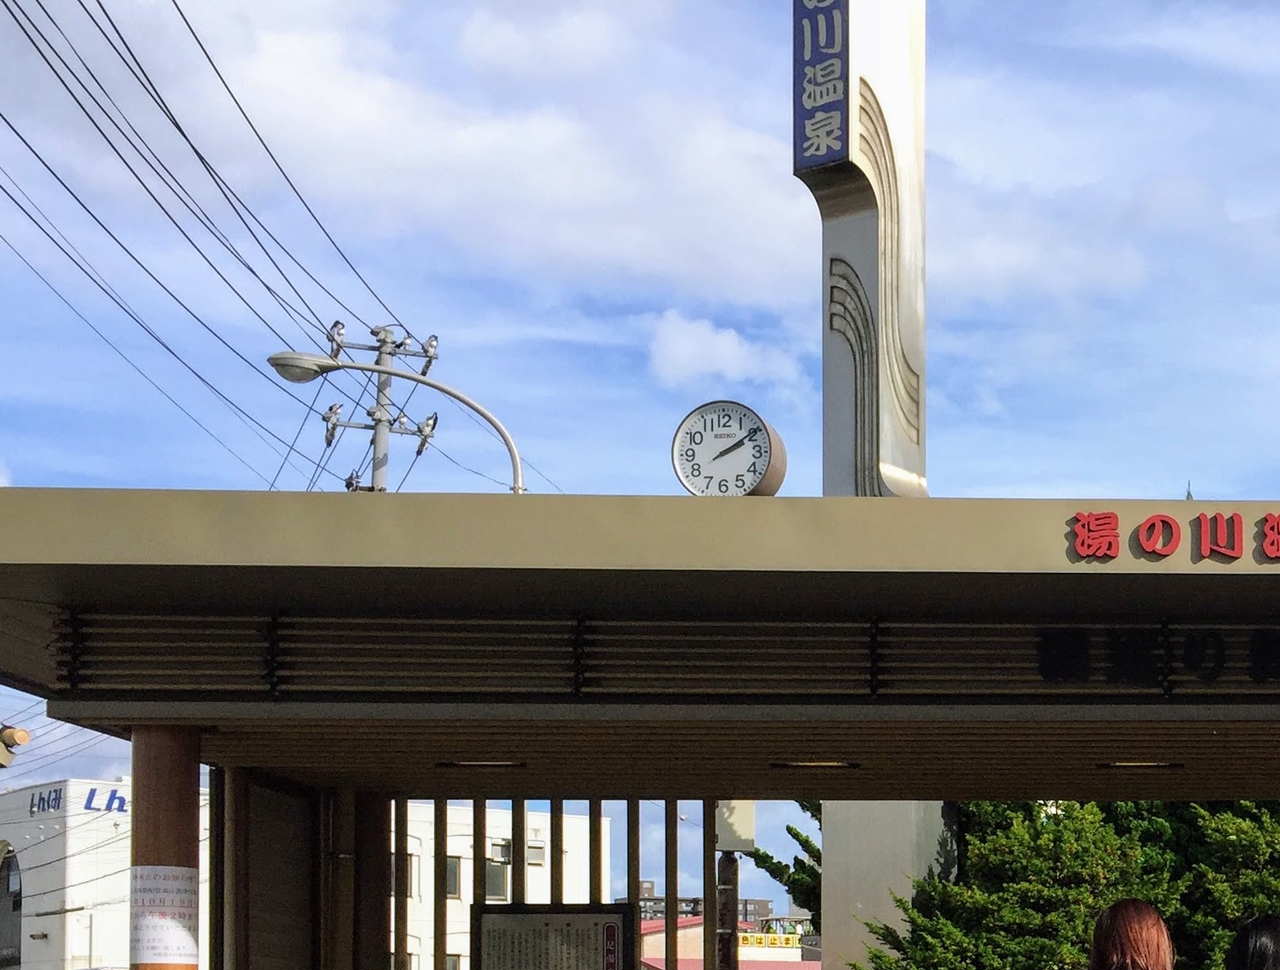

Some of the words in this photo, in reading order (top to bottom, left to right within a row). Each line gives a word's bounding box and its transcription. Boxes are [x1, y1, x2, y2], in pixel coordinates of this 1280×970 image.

[704, 418, 714, 432] 11
[718, 414, 732, 428] 12
[689, 431, 703, 445] 10
[748, 428, 758, 441] 2
[685, 448, 695, 462] 9
[752, 445, 763, 459] 3
[691, 463, 701, 477] 8
[747, 462, 758, 476] 4
[704, 476, 714, 490] 7
[718, 479, 729, 493] 6
[735, 474, 745, 489] 5
